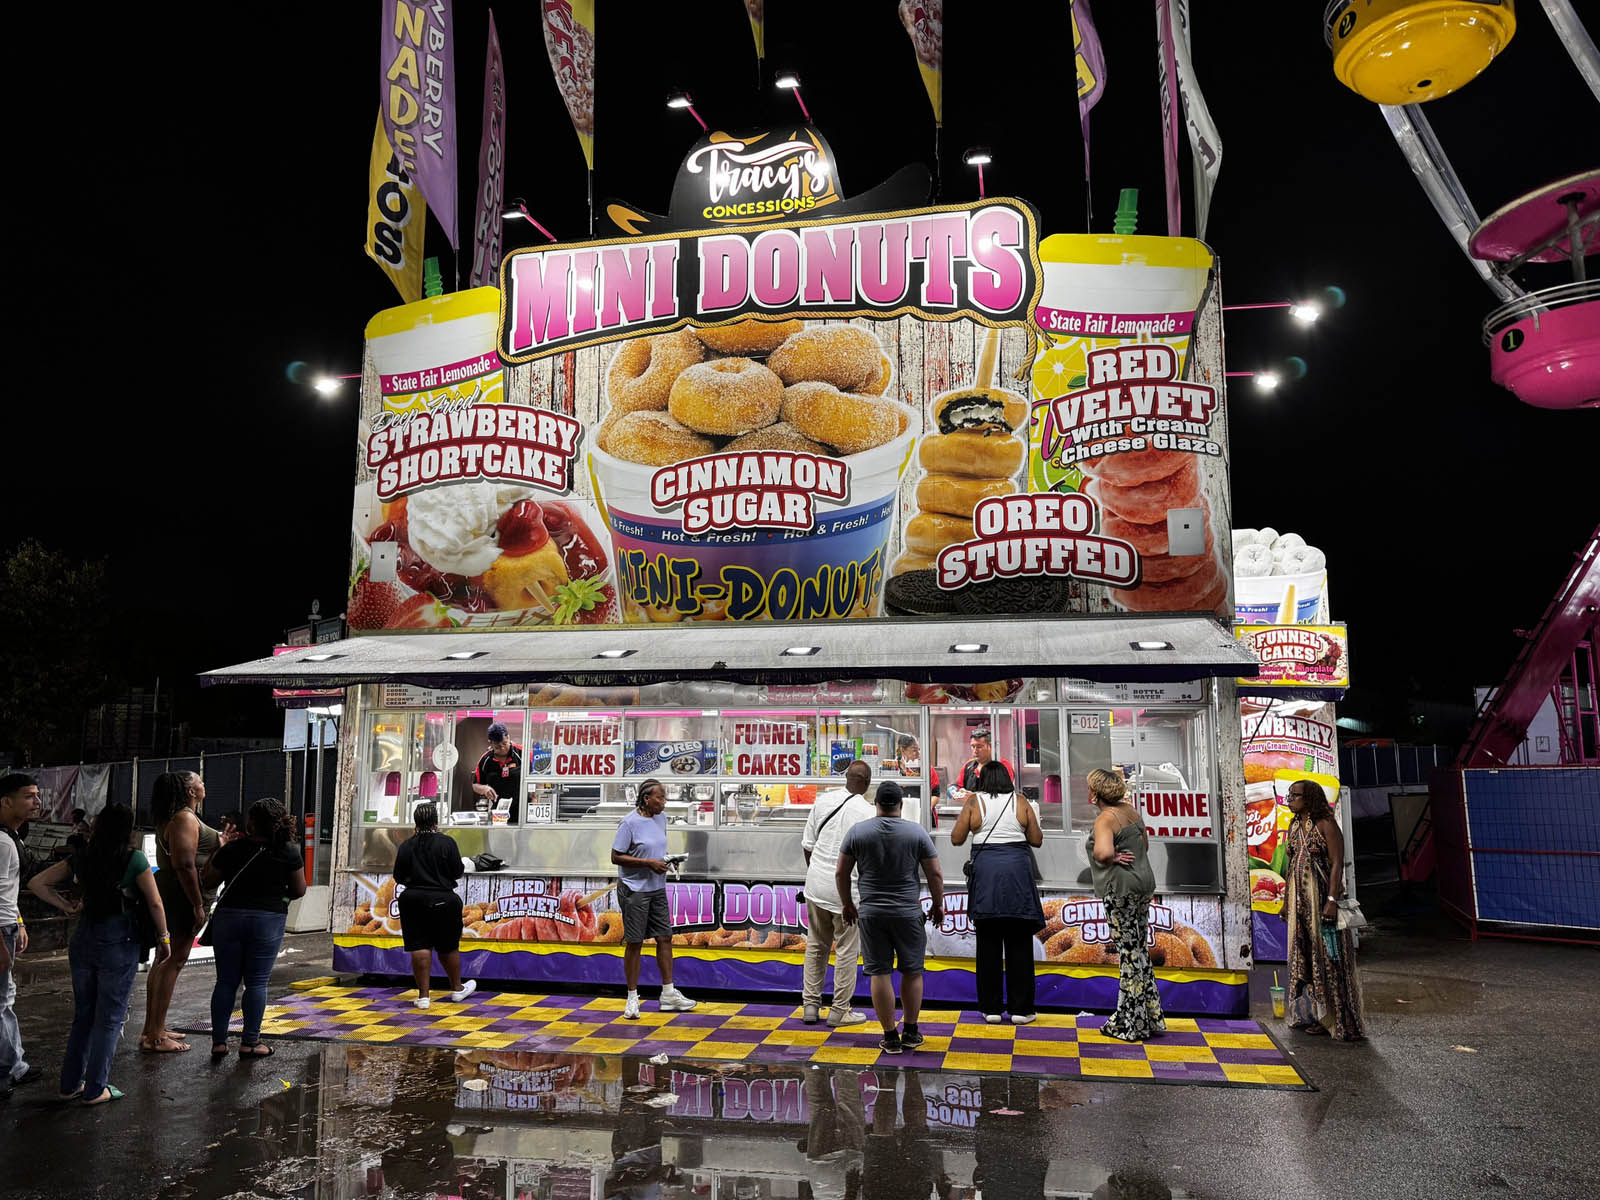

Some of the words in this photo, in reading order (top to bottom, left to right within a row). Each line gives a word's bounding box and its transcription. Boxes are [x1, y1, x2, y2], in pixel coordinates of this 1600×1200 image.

[1341, 13, 1354, 35] 2
[687, 141, 832, 212] Tracy's
[702, 196, 818, 219] CONCESSIONS
[509, 240, 680, 355] MINI
[696, 205, 1025, 315] DONUTS
[1050, 311, 1081, 332] State
[1085, 314, 1108, 333] Fair
[1111, 314, 1176, 334] Lemonade
[1507, 330, 1518, 350] 1
[392, 373, 418, 393] State
[420, 369, 439, 388] Fair
[440, 358, 492, 385] Lemonade
[1092, 348, 1173, 385] RED
[370, 408, 419, 433] Deep
[427, 386, 481, 419] Fried
[1054, 386, 1214, 432] VELVET
[368, 408, 577, 463] STRAWBERRY
[1071, 421, 1130, 446] With
[1131, 416, 1208, 436] Cream
[1061, 437, 1146, 464] Cheese
[1154, 433, 1220, 456] Glaze
[380, 442, 567, 495] SHORTCAKE
[655, 455, 843, 503] CINNAMON
[687, 491, 810, 530] SUGAR
[979, 498, 1089, 532] OREO
[618, 521, 644, 537] Fresh!
[817, 524, 828, 535] &
[831, 514, 870, 533] Fresh!
[662, 530, 685, 542] Hot
[706, 532, 756, 543] Fresh!
[942, 537, 1132, 583] STUFFED
[1255, 629, 1321, 648] FUNNEL
[1261, 645, 1316, 662] CAKES
[734, 724, 805, 745] FUNNEL
[1080, 716, 1099, 730] 012
[554, 724, 621, 746] FUNNEL
[658, 741, 703, 760] OREO
[1267, 741, 1288, 750] Cream
[1290, 744, 1315, 756] Cheese
[1316, 749, 1334, 763] Icing
[556, 753, 616, 776] CAKES
[737, 753, 801, 776] CAKES
[535, 806, 550, 818] 015
[1247, 821, 1273, 838] Tea
[513, 880, 545, 895] RED
[498, 896, 558, 913] VELVET
